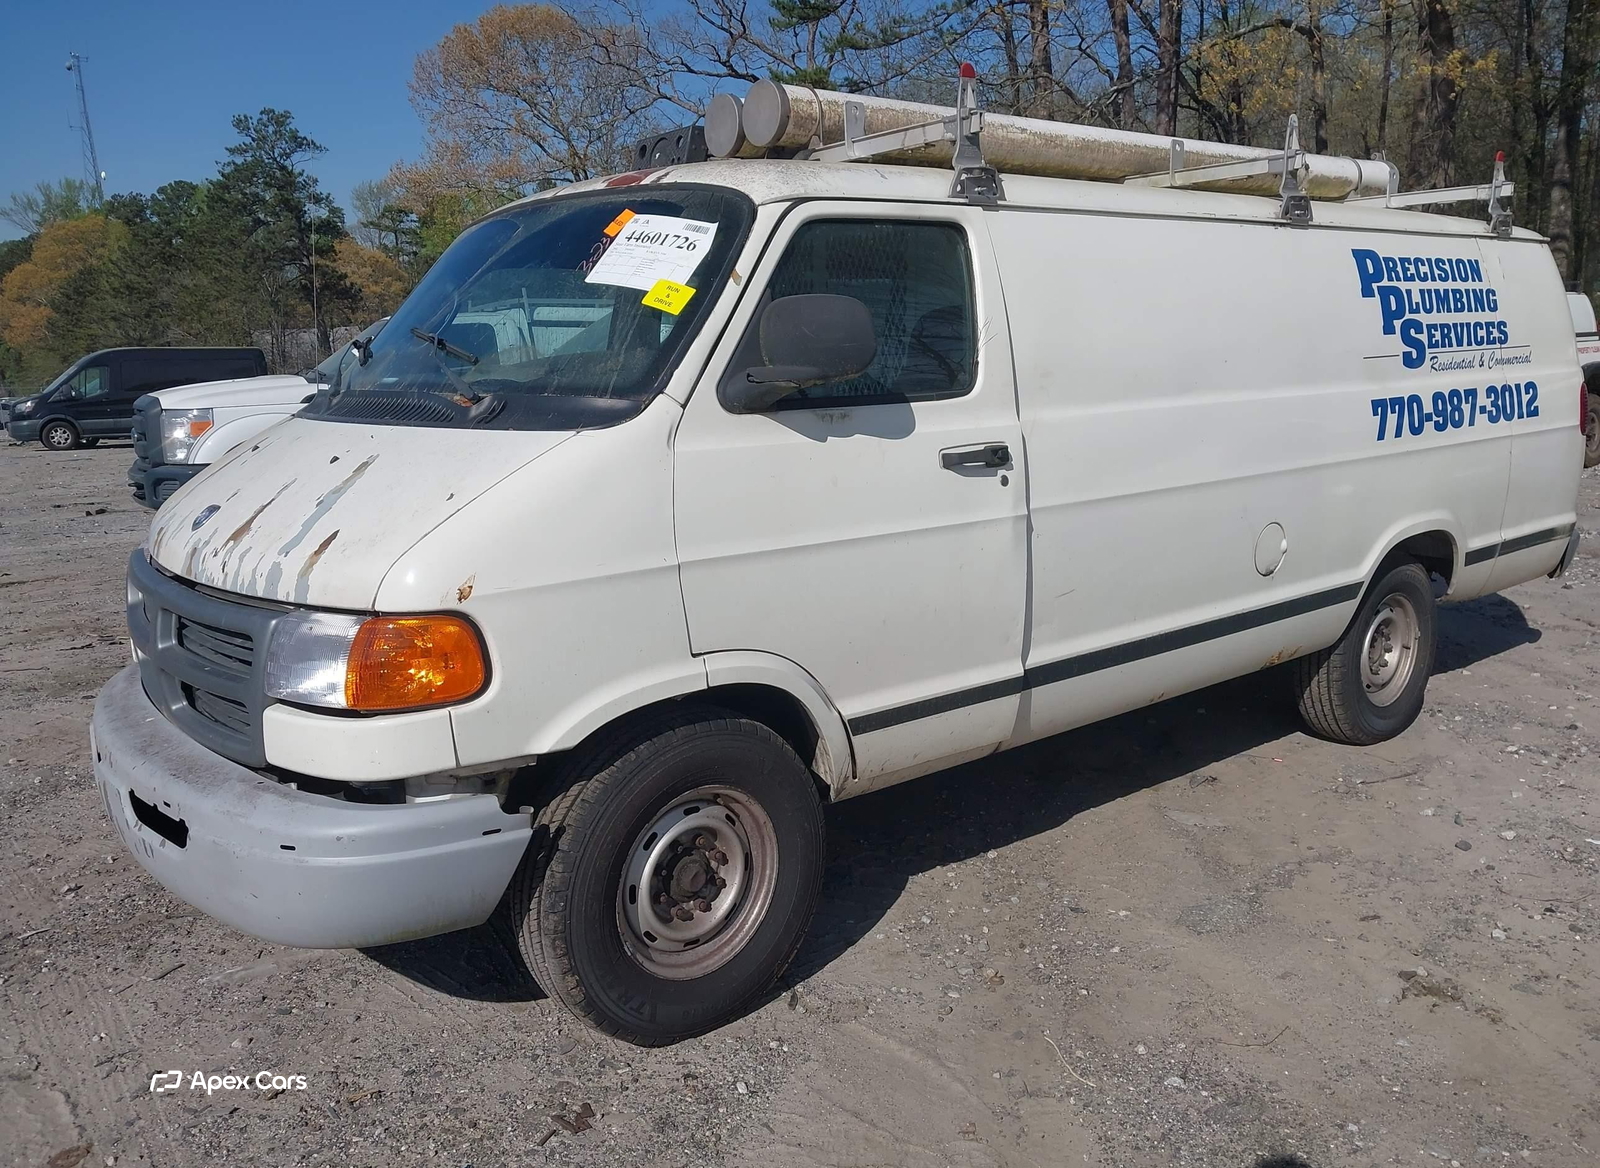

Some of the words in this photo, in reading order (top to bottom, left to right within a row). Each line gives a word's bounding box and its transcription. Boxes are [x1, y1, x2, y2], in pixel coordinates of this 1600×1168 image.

[625, 229, 701, 252] 44601726
[666, 285, 680, 294] RUN
[1351, 248, 1483, 298] PRECISION
[654, 297, 674, 308] DRIVE
[1377, 285, 1499, 335] PLUMBING
[1400, 318, 1509, 369] SERVICES
[1429, 353, 1476, 373] Residential
[1478, 352, 1485, 368] &
[1487, 350, 1533, 370] Commercial
[1371, 380, 1540, 441] 770-987-3012
